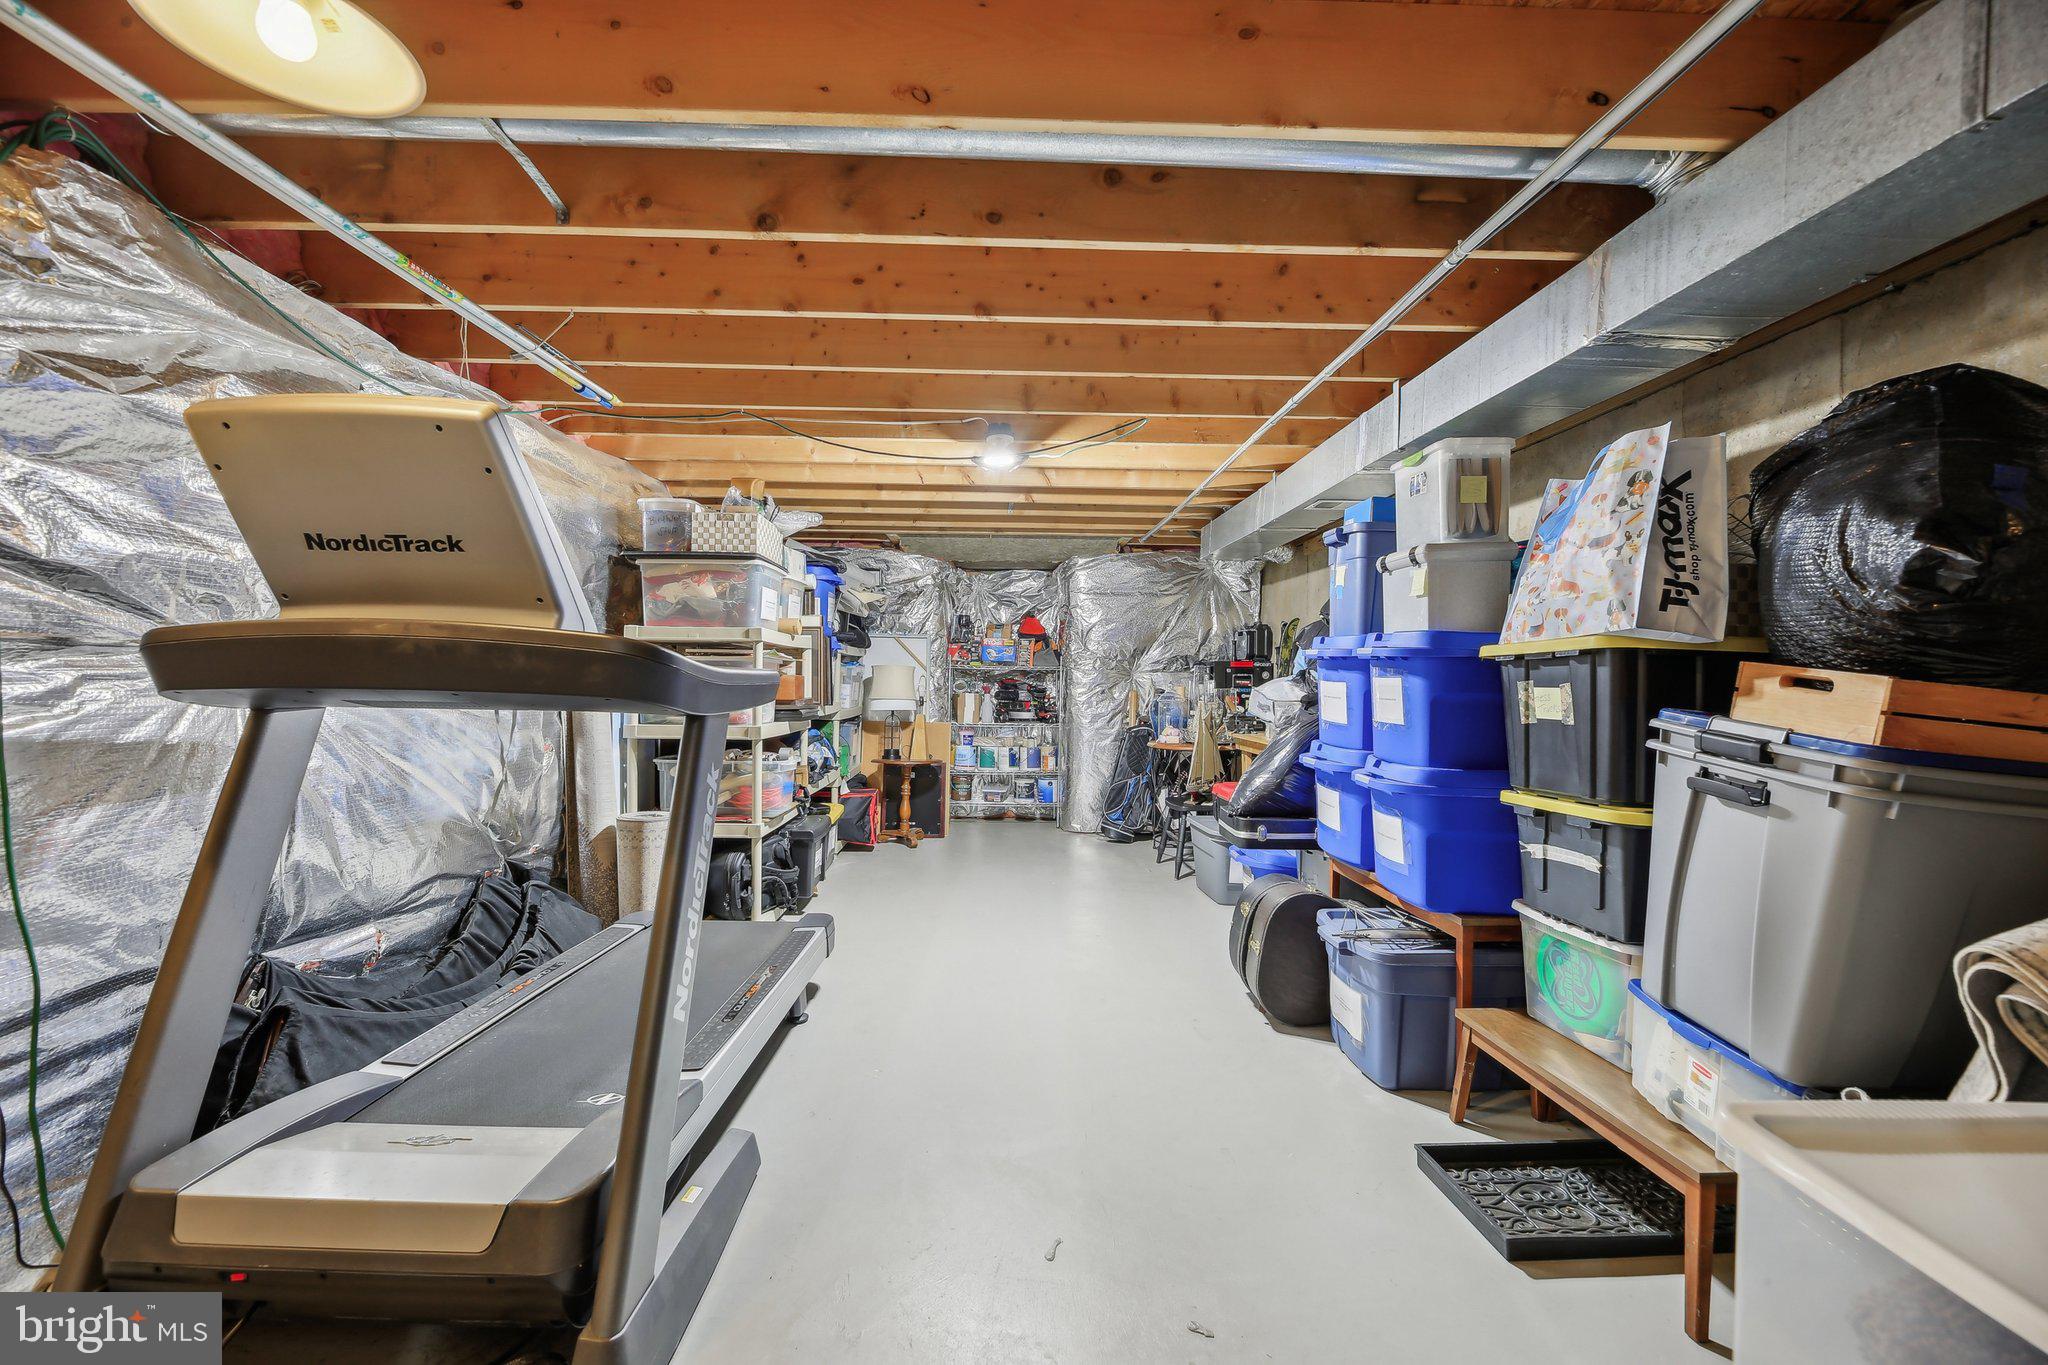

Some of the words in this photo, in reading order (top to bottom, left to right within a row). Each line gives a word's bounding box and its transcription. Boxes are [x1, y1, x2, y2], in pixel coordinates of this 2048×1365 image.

[303, 533, 466, 553] NordicTrack
[1689, 554, 1702, 581] shop
[673, 762, 720, 1022] NordicTrack
